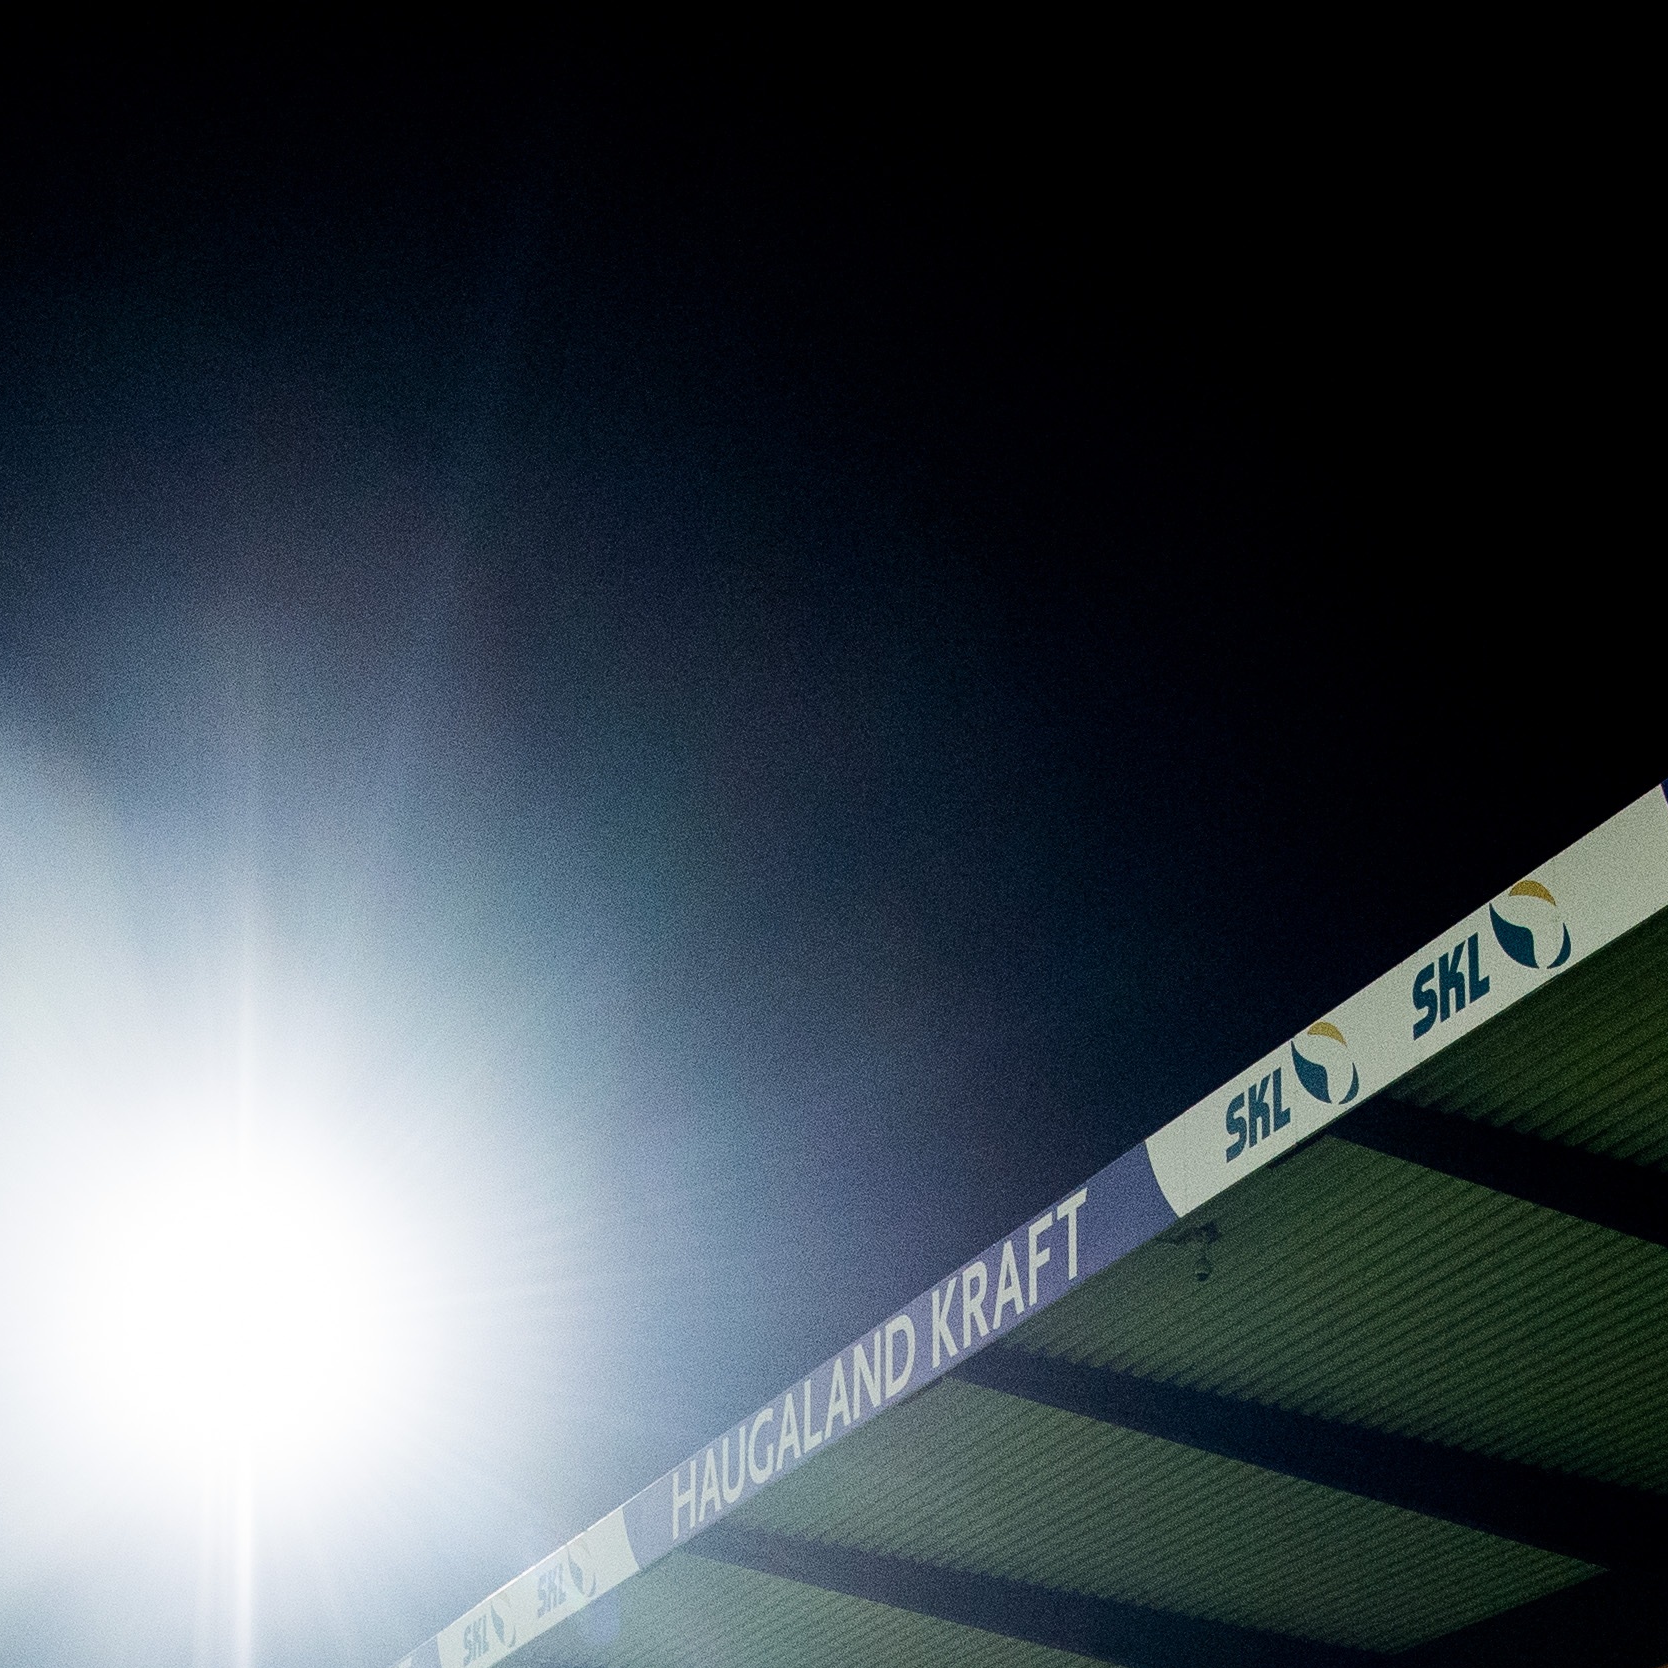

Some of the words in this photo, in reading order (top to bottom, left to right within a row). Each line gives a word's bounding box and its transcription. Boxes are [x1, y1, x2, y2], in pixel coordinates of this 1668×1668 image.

[1413, 932, 1490, 1041] SKL
[1226, 1066, 1291, 1163] SKL
[672, 1314, 916, 1540] HAUGALAND
[931, 1188, 1088, 1368] KRAFT
[537, 1563, 566, 1618] SKL
[463, 1614, 489, 1667] SKL
